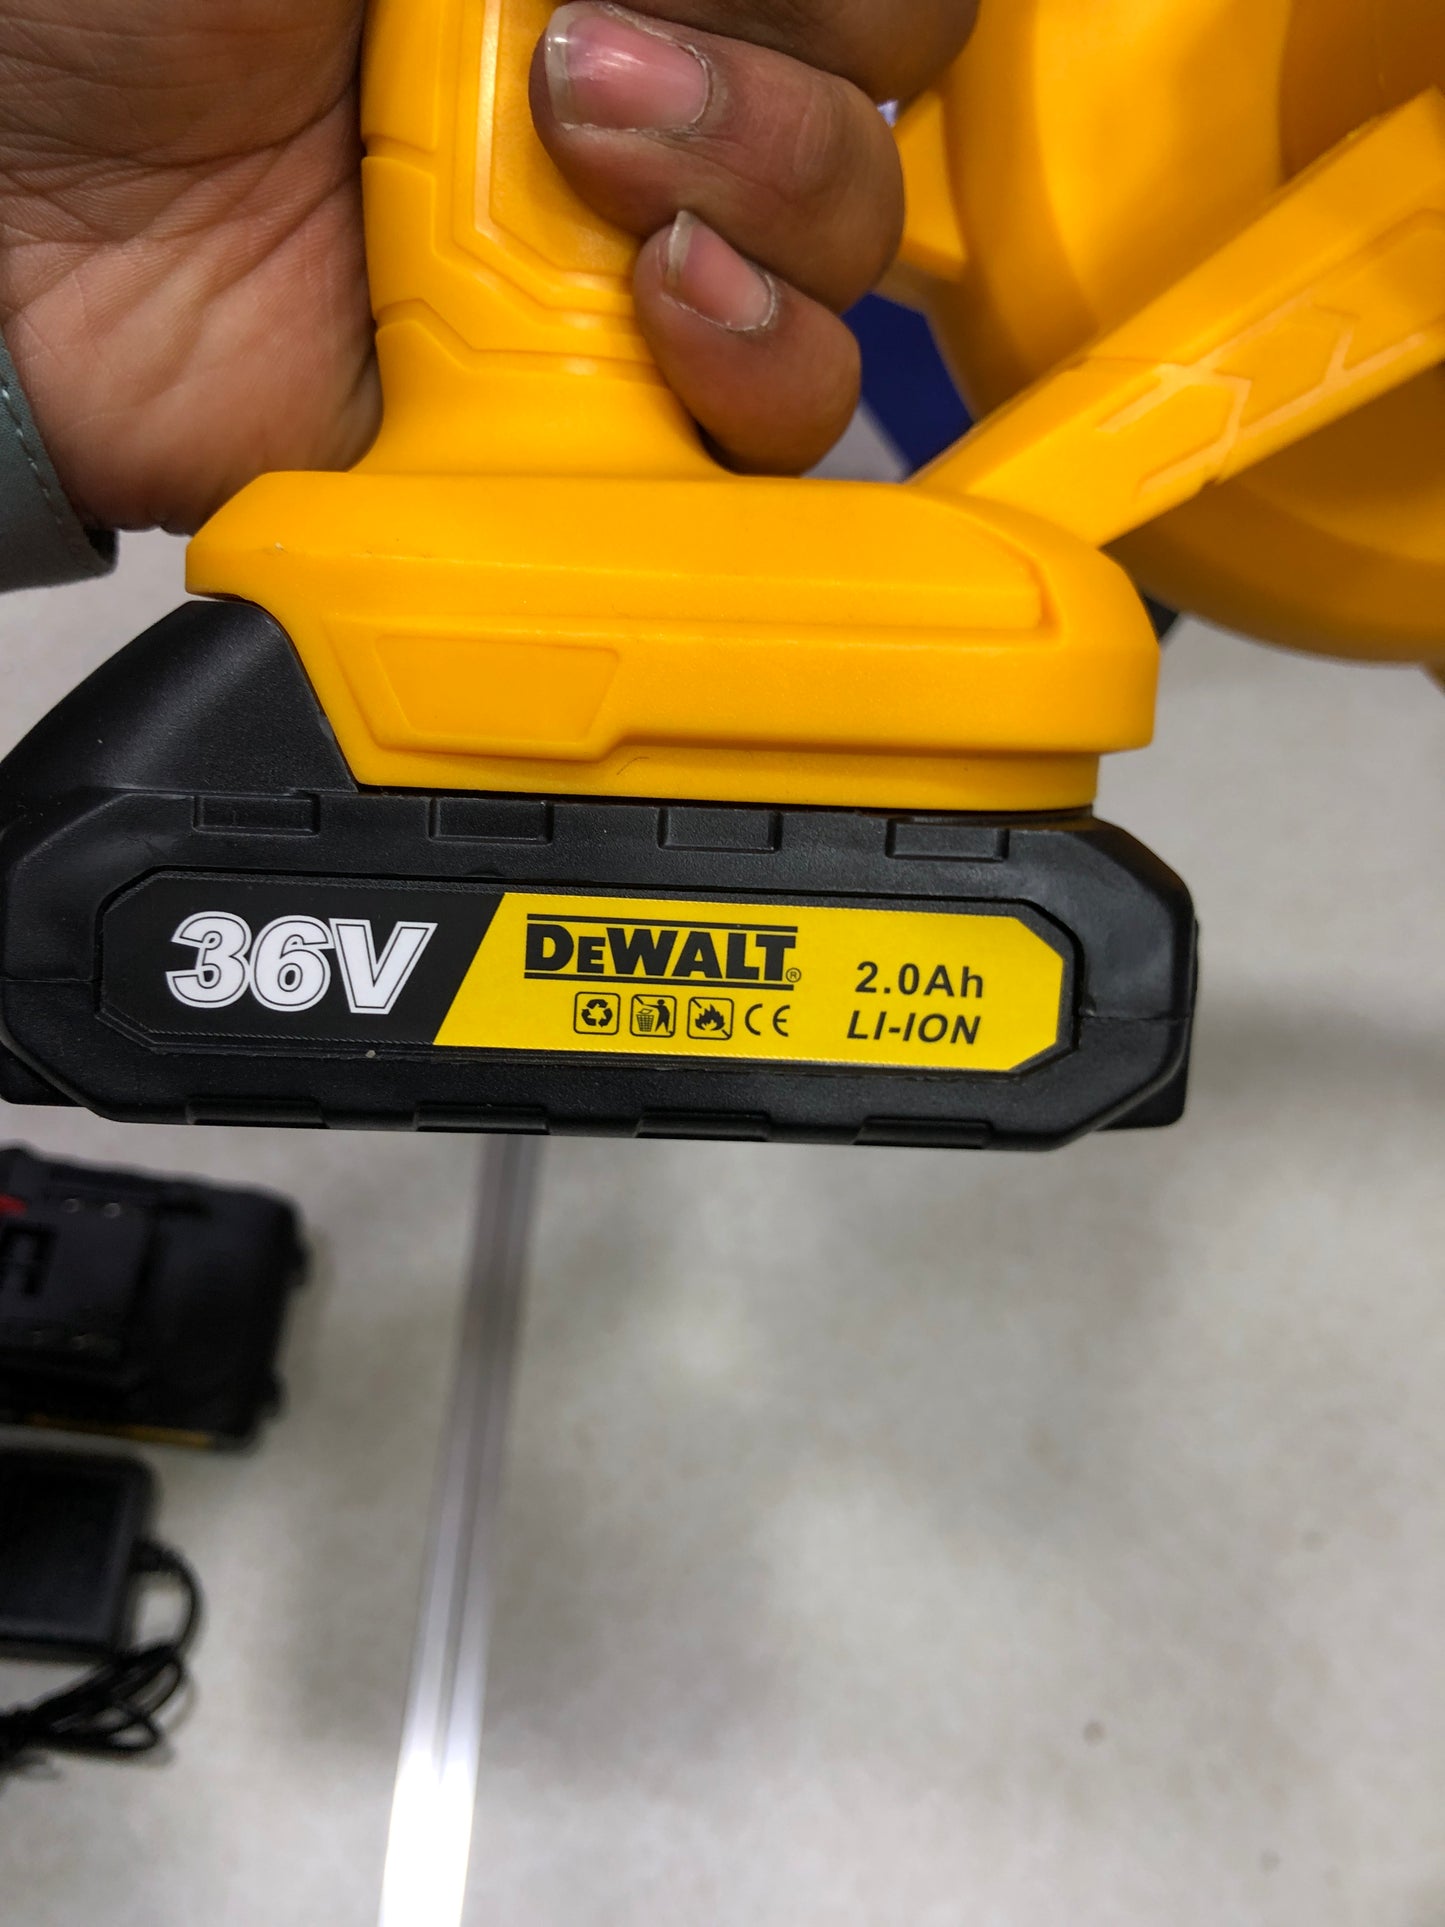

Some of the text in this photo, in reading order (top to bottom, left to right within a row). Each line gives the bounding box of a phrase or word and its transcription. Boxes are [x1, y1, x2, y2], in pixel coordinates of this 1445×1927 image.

[165, 910, 439, 1015] 36V
[855, 961, 984, 998] 2.0Ah
[744, 1003, 791, 1038] CE
[846, 1010, 982, 1045] LI-ION
